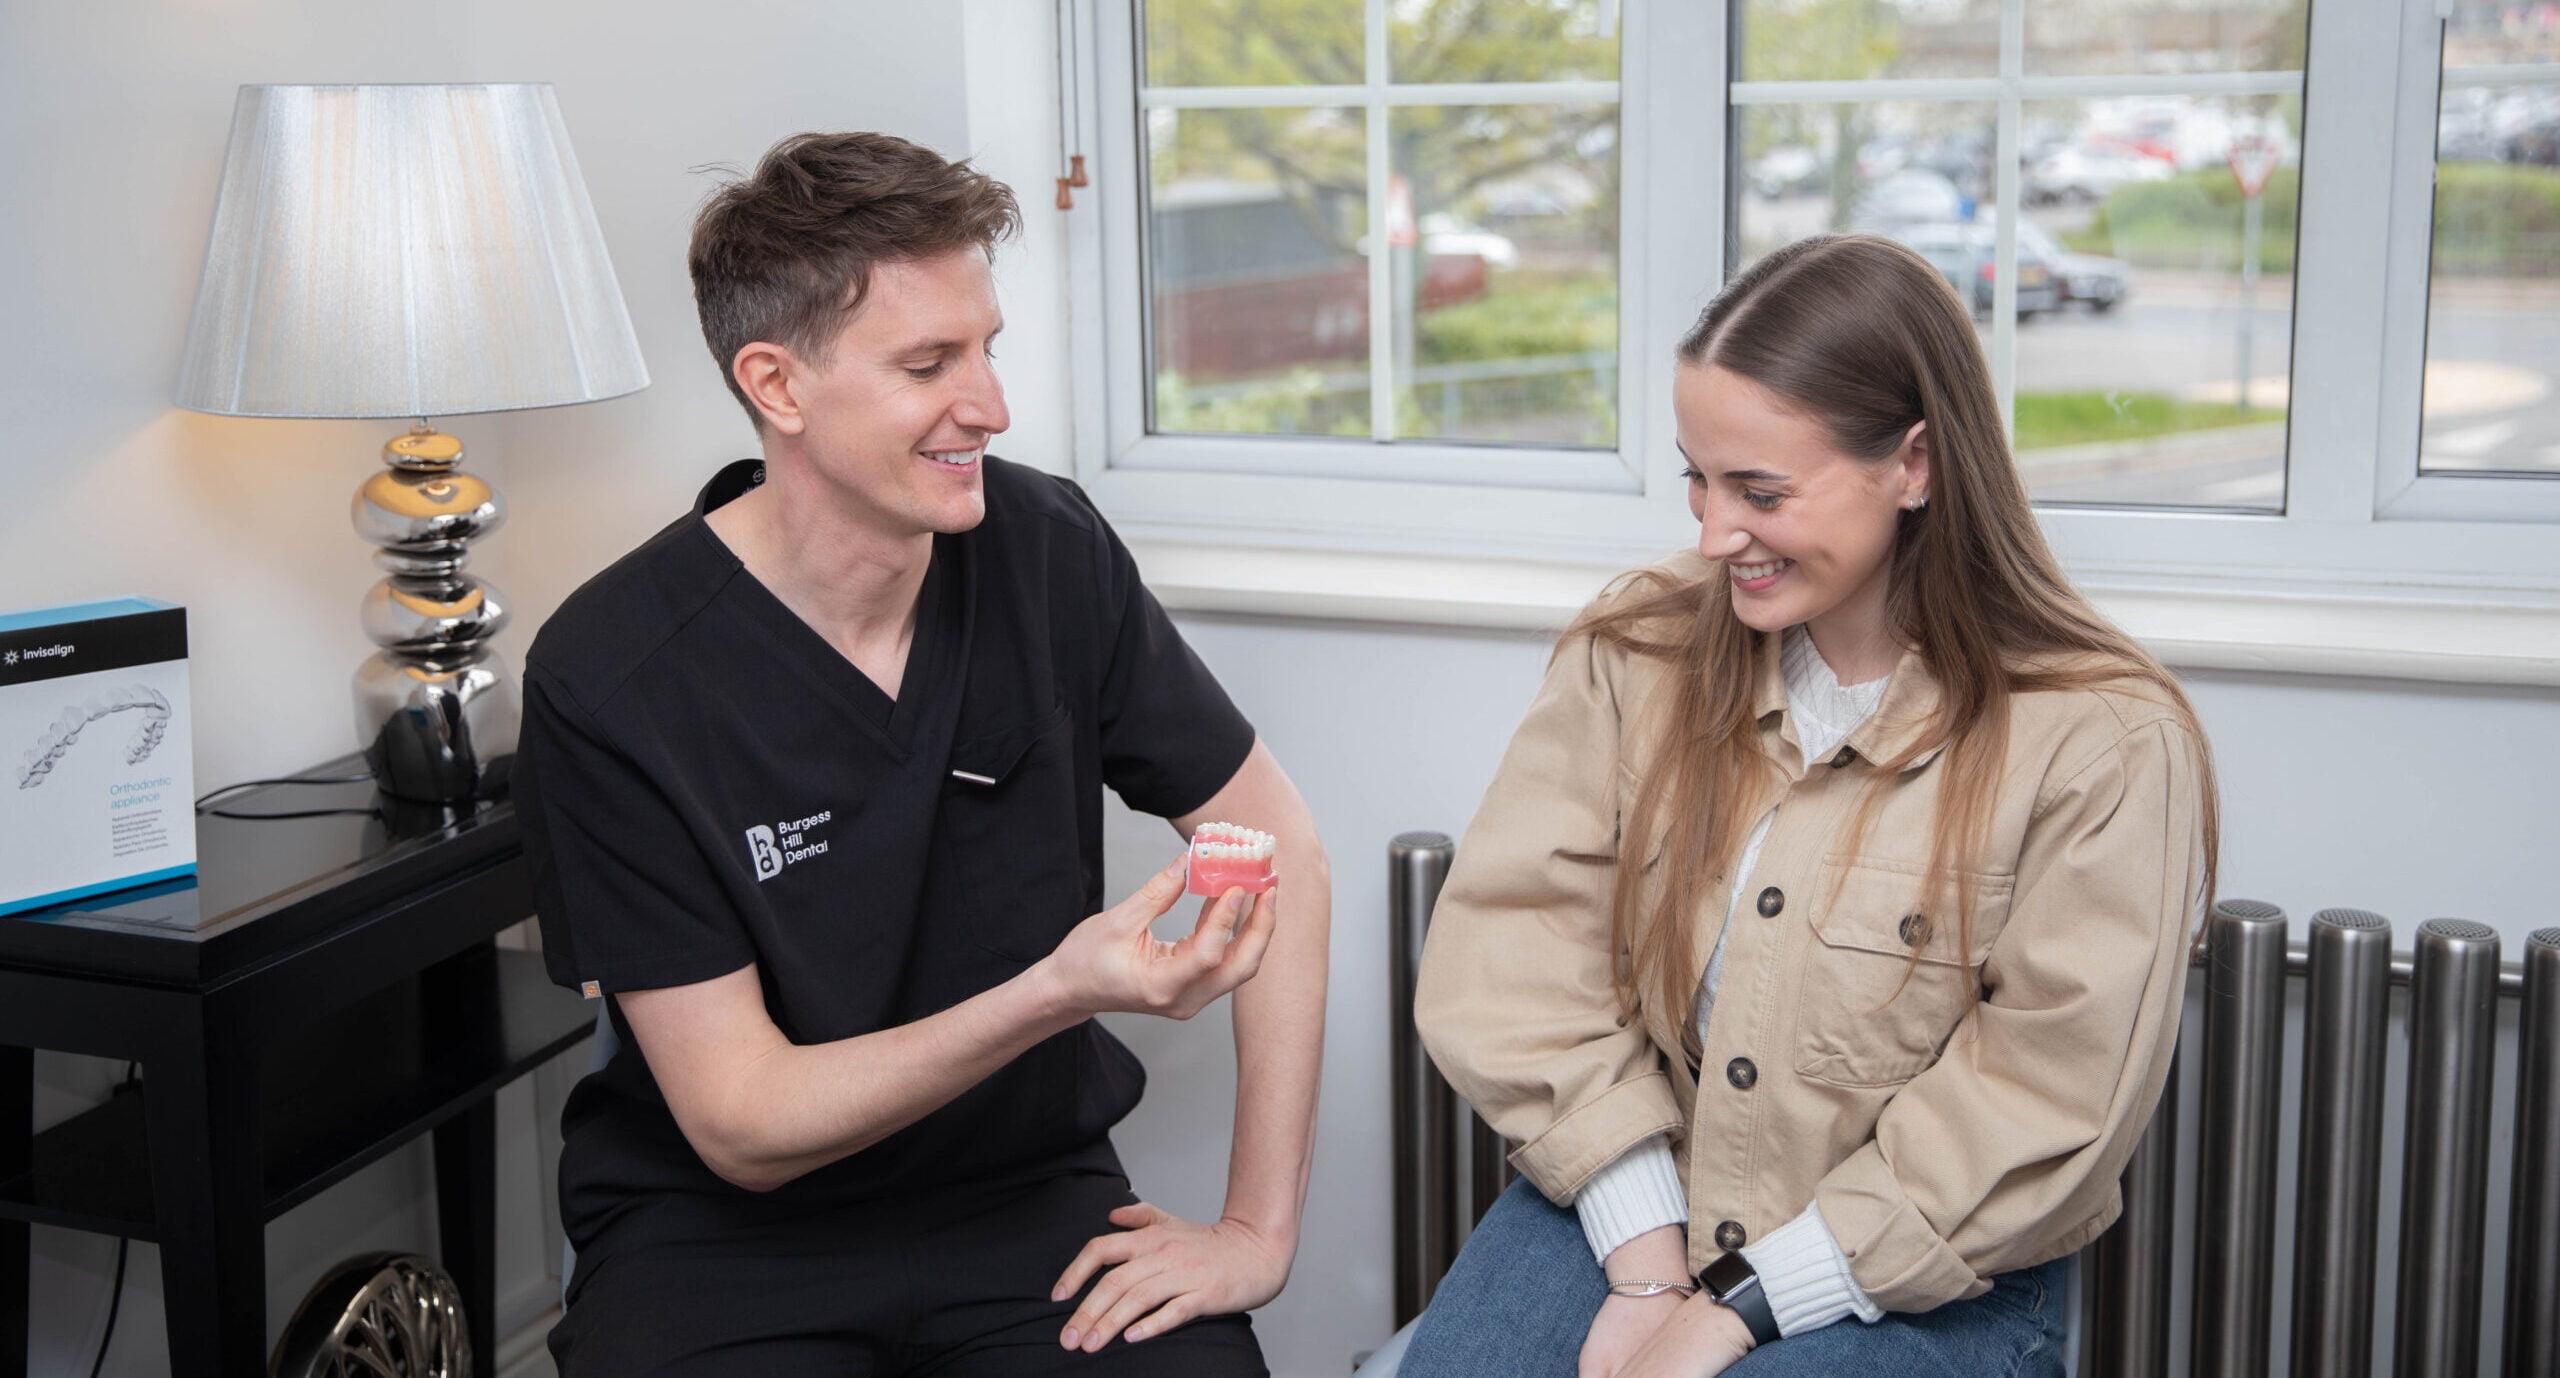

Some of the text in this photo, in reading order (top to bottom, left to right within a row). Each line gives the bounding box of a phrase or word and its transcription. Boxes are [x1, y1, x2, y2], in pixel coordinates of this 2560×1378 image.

[23, 644, 75, 660] invisalign
[110, 777, 172, 795] Orthodontic
[111, 792, 161, 810] appliance
[778, 810, 831, 835] Burgess
[782, 833, 803, 850] Hill
[785, 840, 829, 865] Dental
